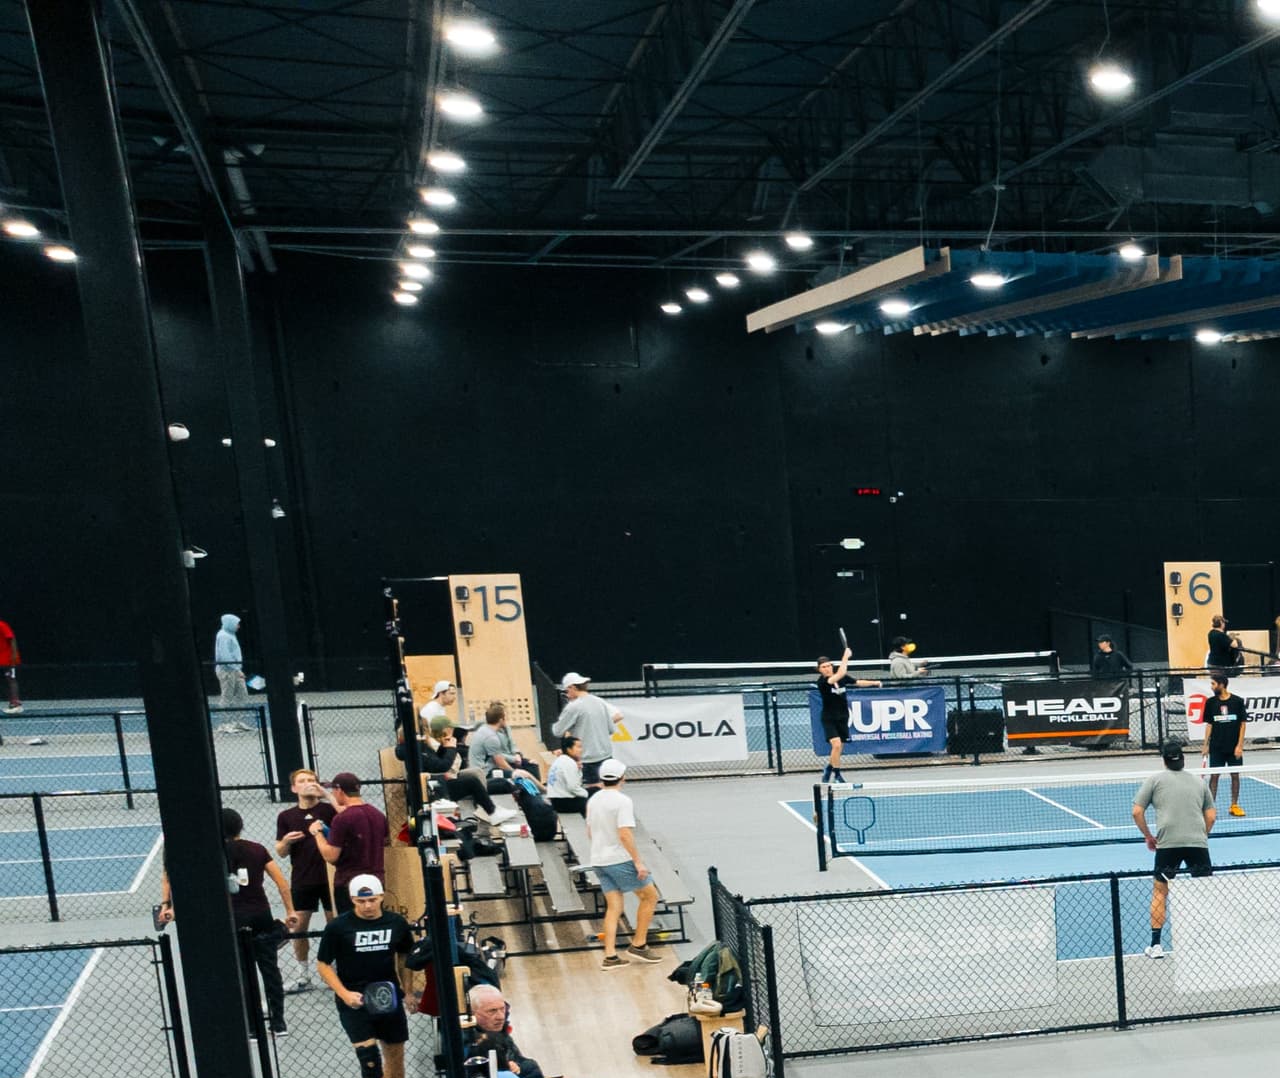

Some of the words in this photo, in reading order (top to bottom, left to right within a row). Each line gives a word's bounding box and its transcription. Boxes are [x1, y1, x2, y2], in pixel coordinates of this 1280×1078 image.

[1189, 572, 1213, 606] 6
[474, 585, 521, 622] 15
[847, 698, 932, 734] UPR
[1007, 697, 1121, 717] HEAD
[1049, 713, 1118, 723] PICKLEBALL
[637, 719, 737, 741] JOOLA
[354, 929, 393, 946] GCU
